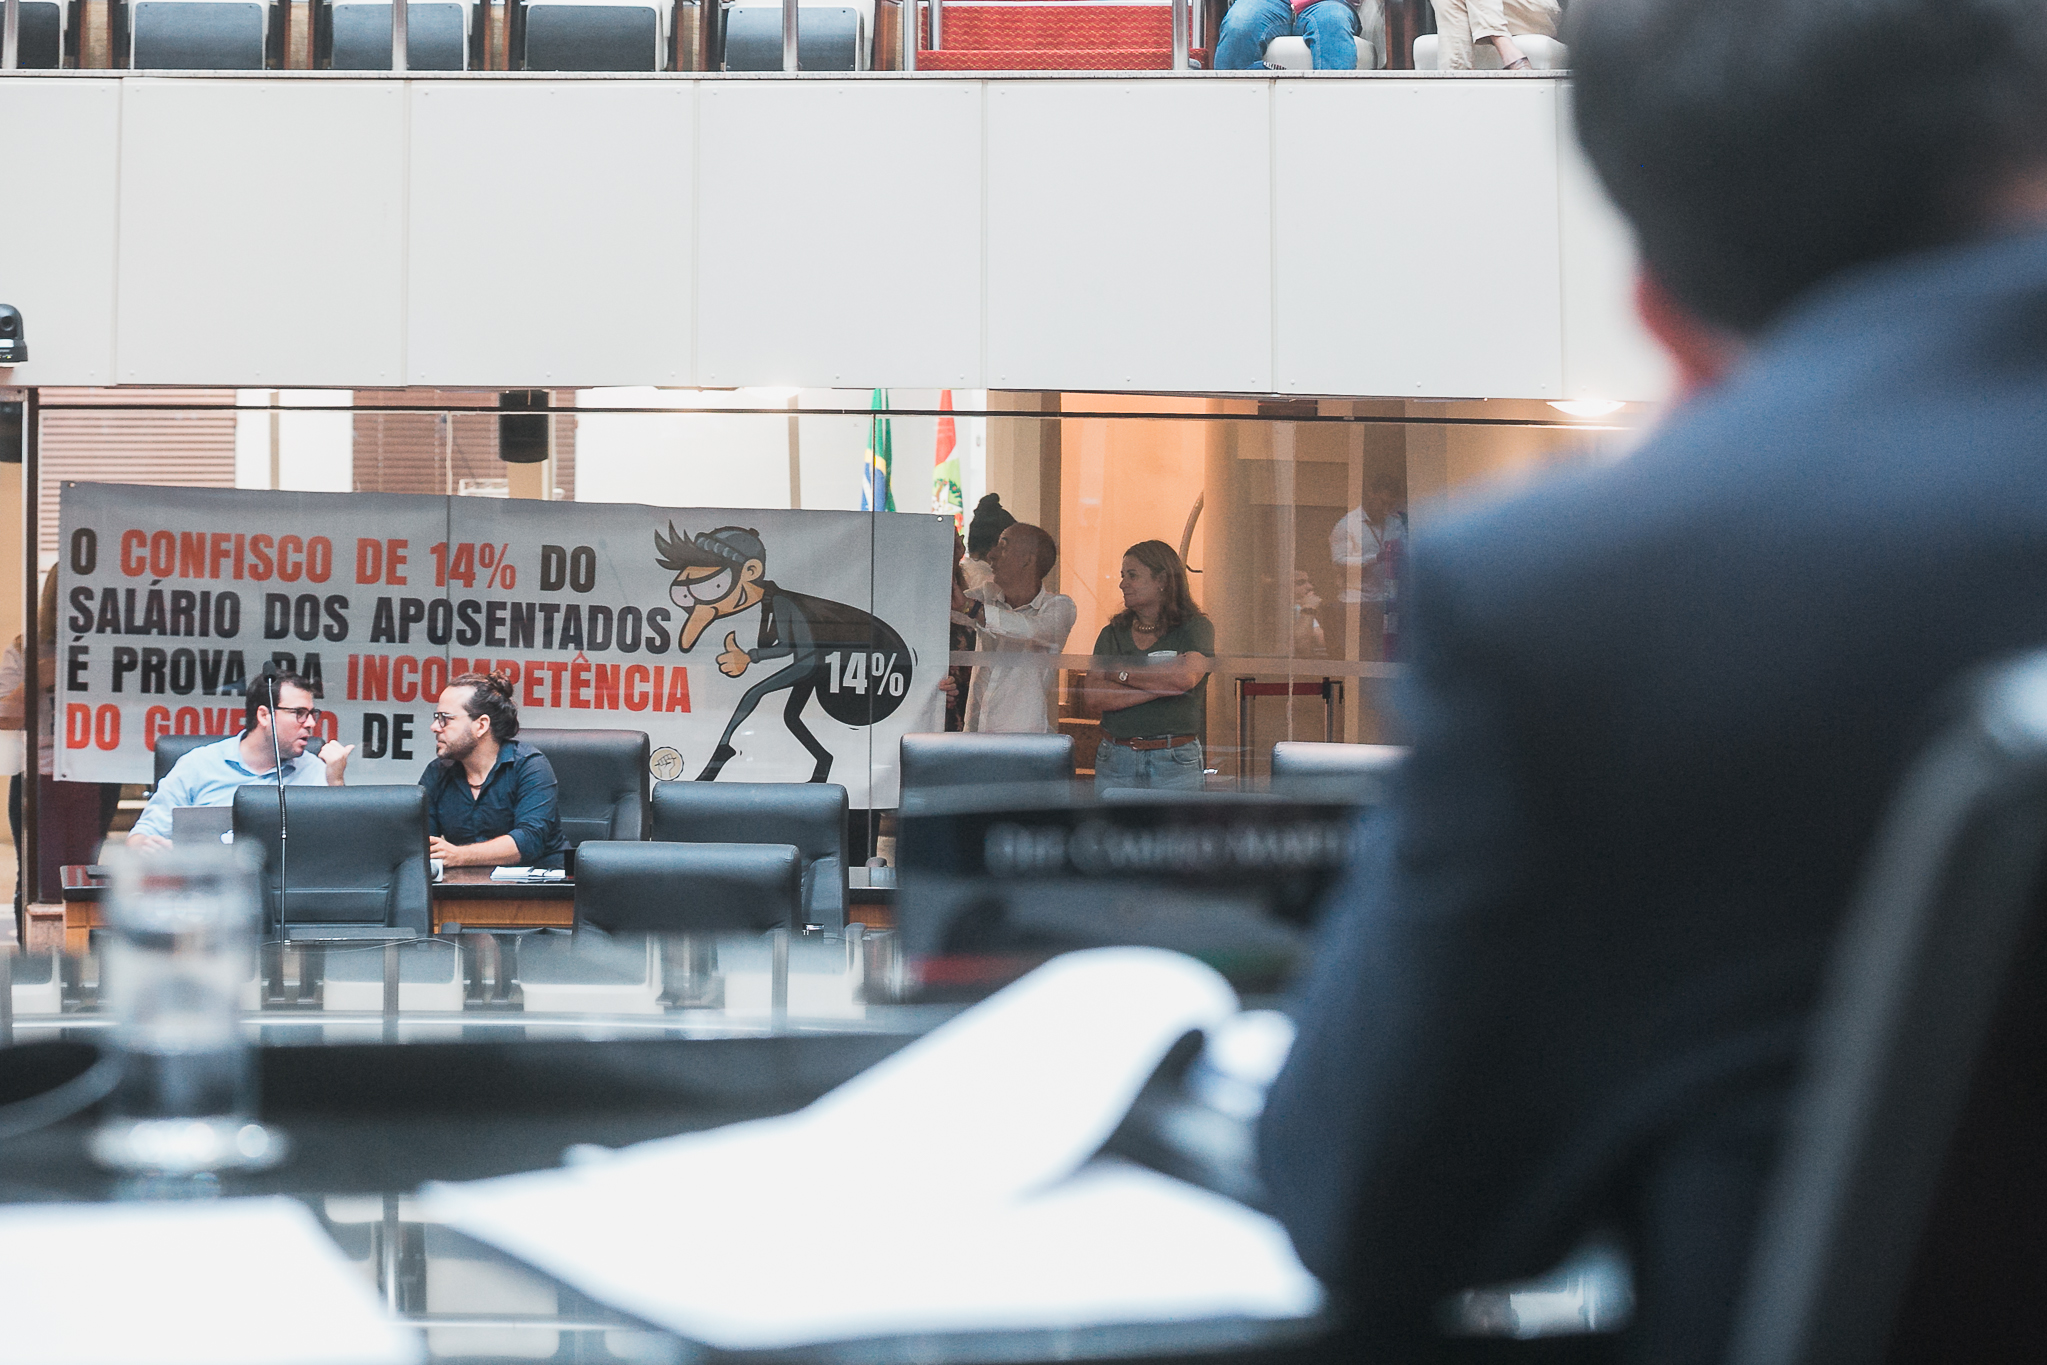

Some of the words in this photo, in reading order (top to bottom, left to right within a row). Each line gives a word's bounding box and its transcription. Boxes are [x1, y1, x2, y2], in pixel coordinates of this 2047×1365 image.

[70, 528, 97, 576] O
[120, 529, 333, 583] CONFISCO
[355, 538, 408, 586] DE
[430, 542, 517, 590] 14%
[540, 544, 596, 593] DO
[68, 580, 240, 638] SALÁRIO
[264, 593, 349, 642] DOS
[370, 596, 672, 654] APOSENTADOS
[66, 636, 88, 692] É
[112, 647, 247, 696] PROVA
[824, 651, 904, 698] 14%
[66, 703, 121, 751] DO
[145, 705, 339, 752] GOVEO
[361, 712, 414, 760] DE
